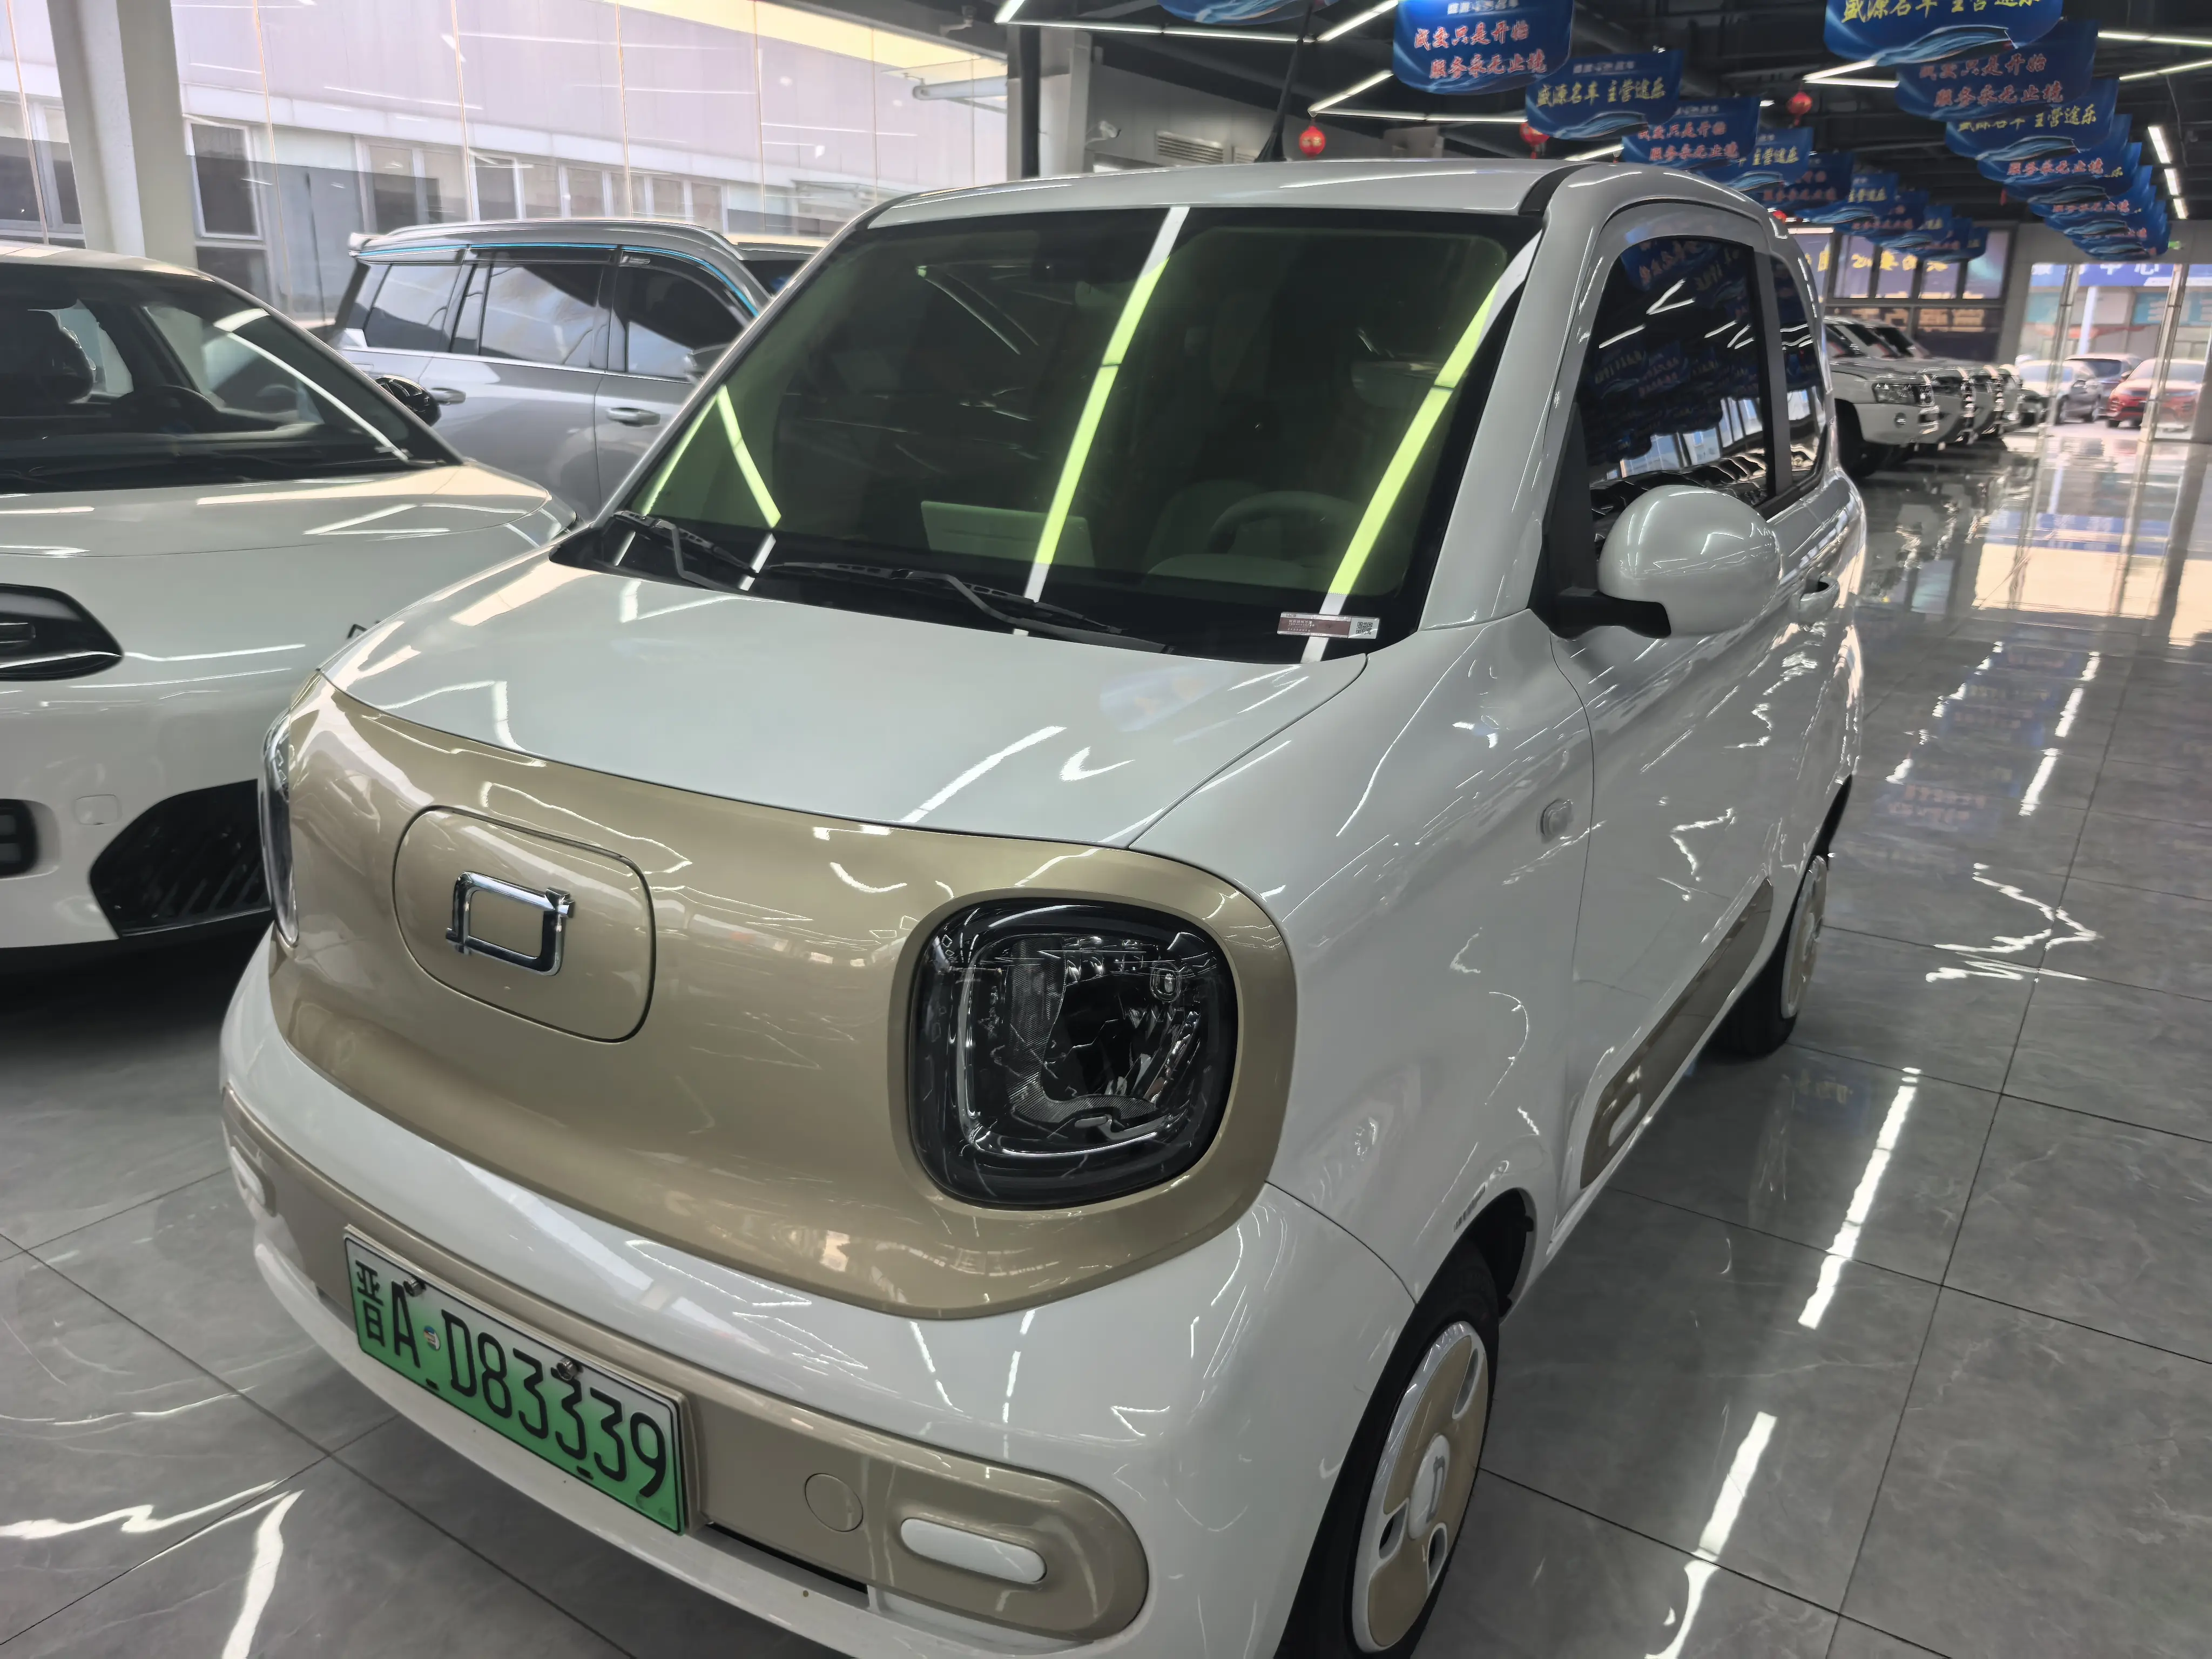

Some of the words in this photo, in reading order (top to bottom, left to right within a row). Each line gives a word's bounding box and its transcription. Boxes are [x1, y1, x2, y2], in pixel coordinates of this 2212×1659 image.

[1414, 20, 1529, 51] 成交只是开始
[1429, 49, 1547, 79] 服务永无止境
[1536, 80, 1600, 107] 盛源名车
